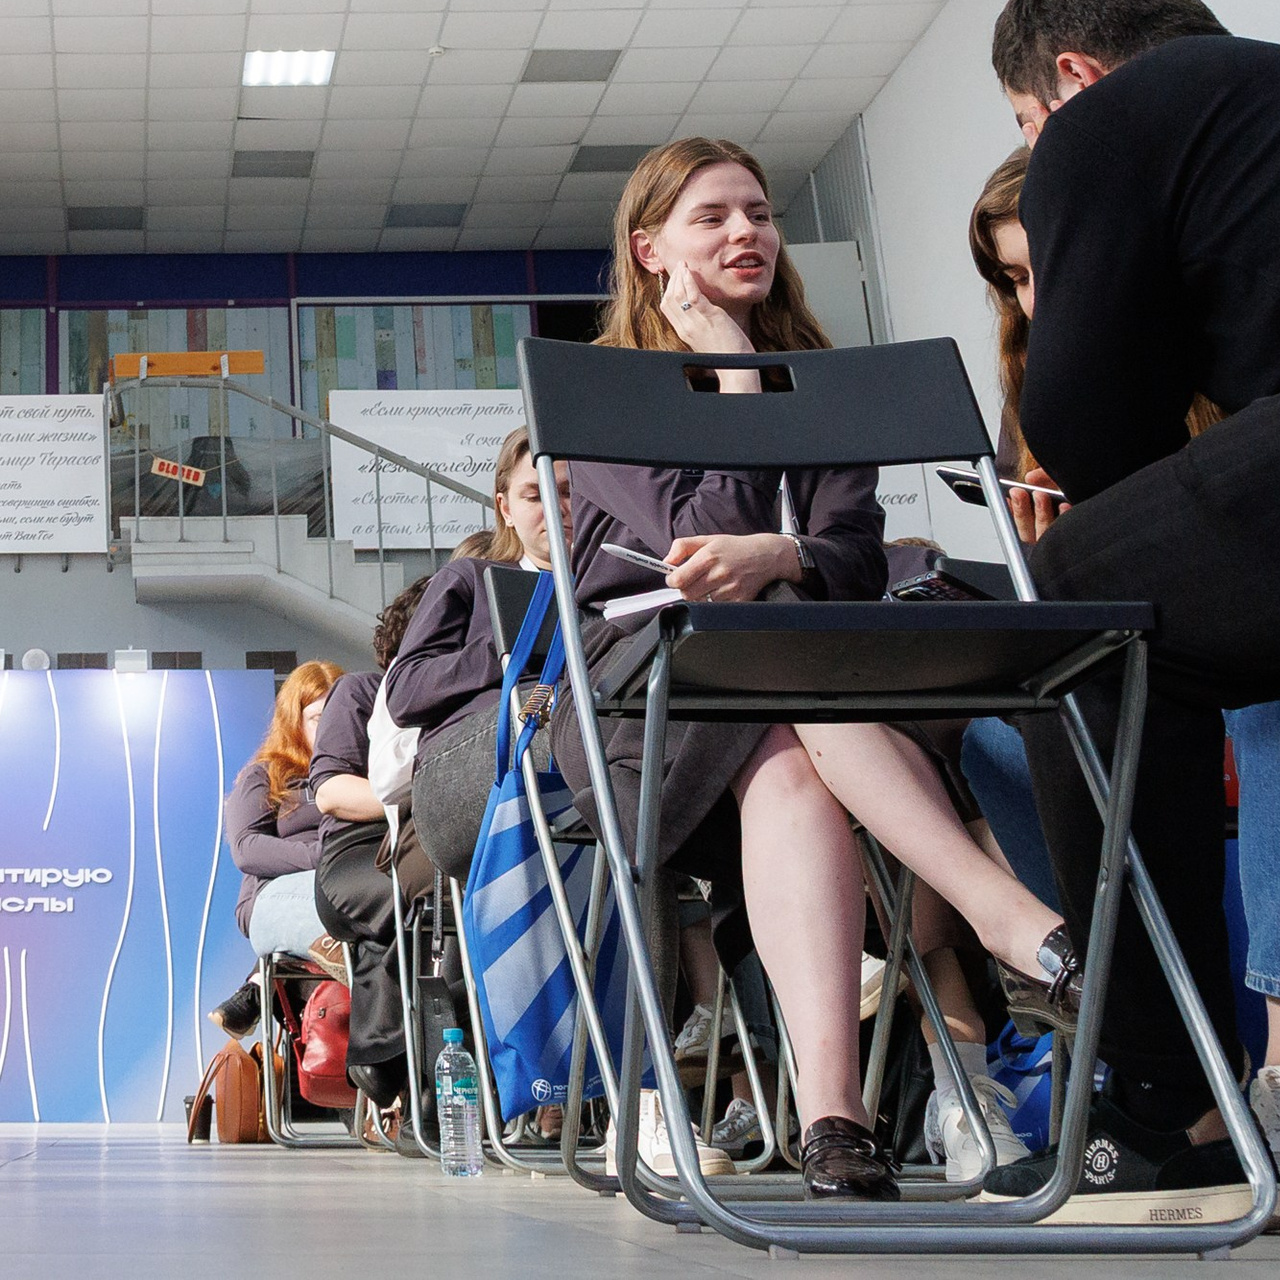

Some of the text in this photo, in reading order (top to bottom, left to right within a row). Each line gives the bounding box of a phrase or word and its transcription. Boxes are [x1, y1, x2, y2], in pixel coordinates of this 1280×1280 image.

[17, 404, 51, 420] свой
[52, 405, 95, 423] путь.
[406, 403, 472, 420] крикнет
[473, 403, 513, 420] рать
[37, 431, 97, 443] жизни»
[40, 451, 101, 470] Тарасов
[20, 516, 45, 525] если
[46, 516, 58, 524] не
[59, 512, 94, 527] будут
[14, 531, 36, 541] Ван
[352, 525, 363, 534] а
[365, 524, 375, 534] в
[1084, 1138, 1119, 1160] HERMES
[1149, 1207, 1203, 1221] HERMES
